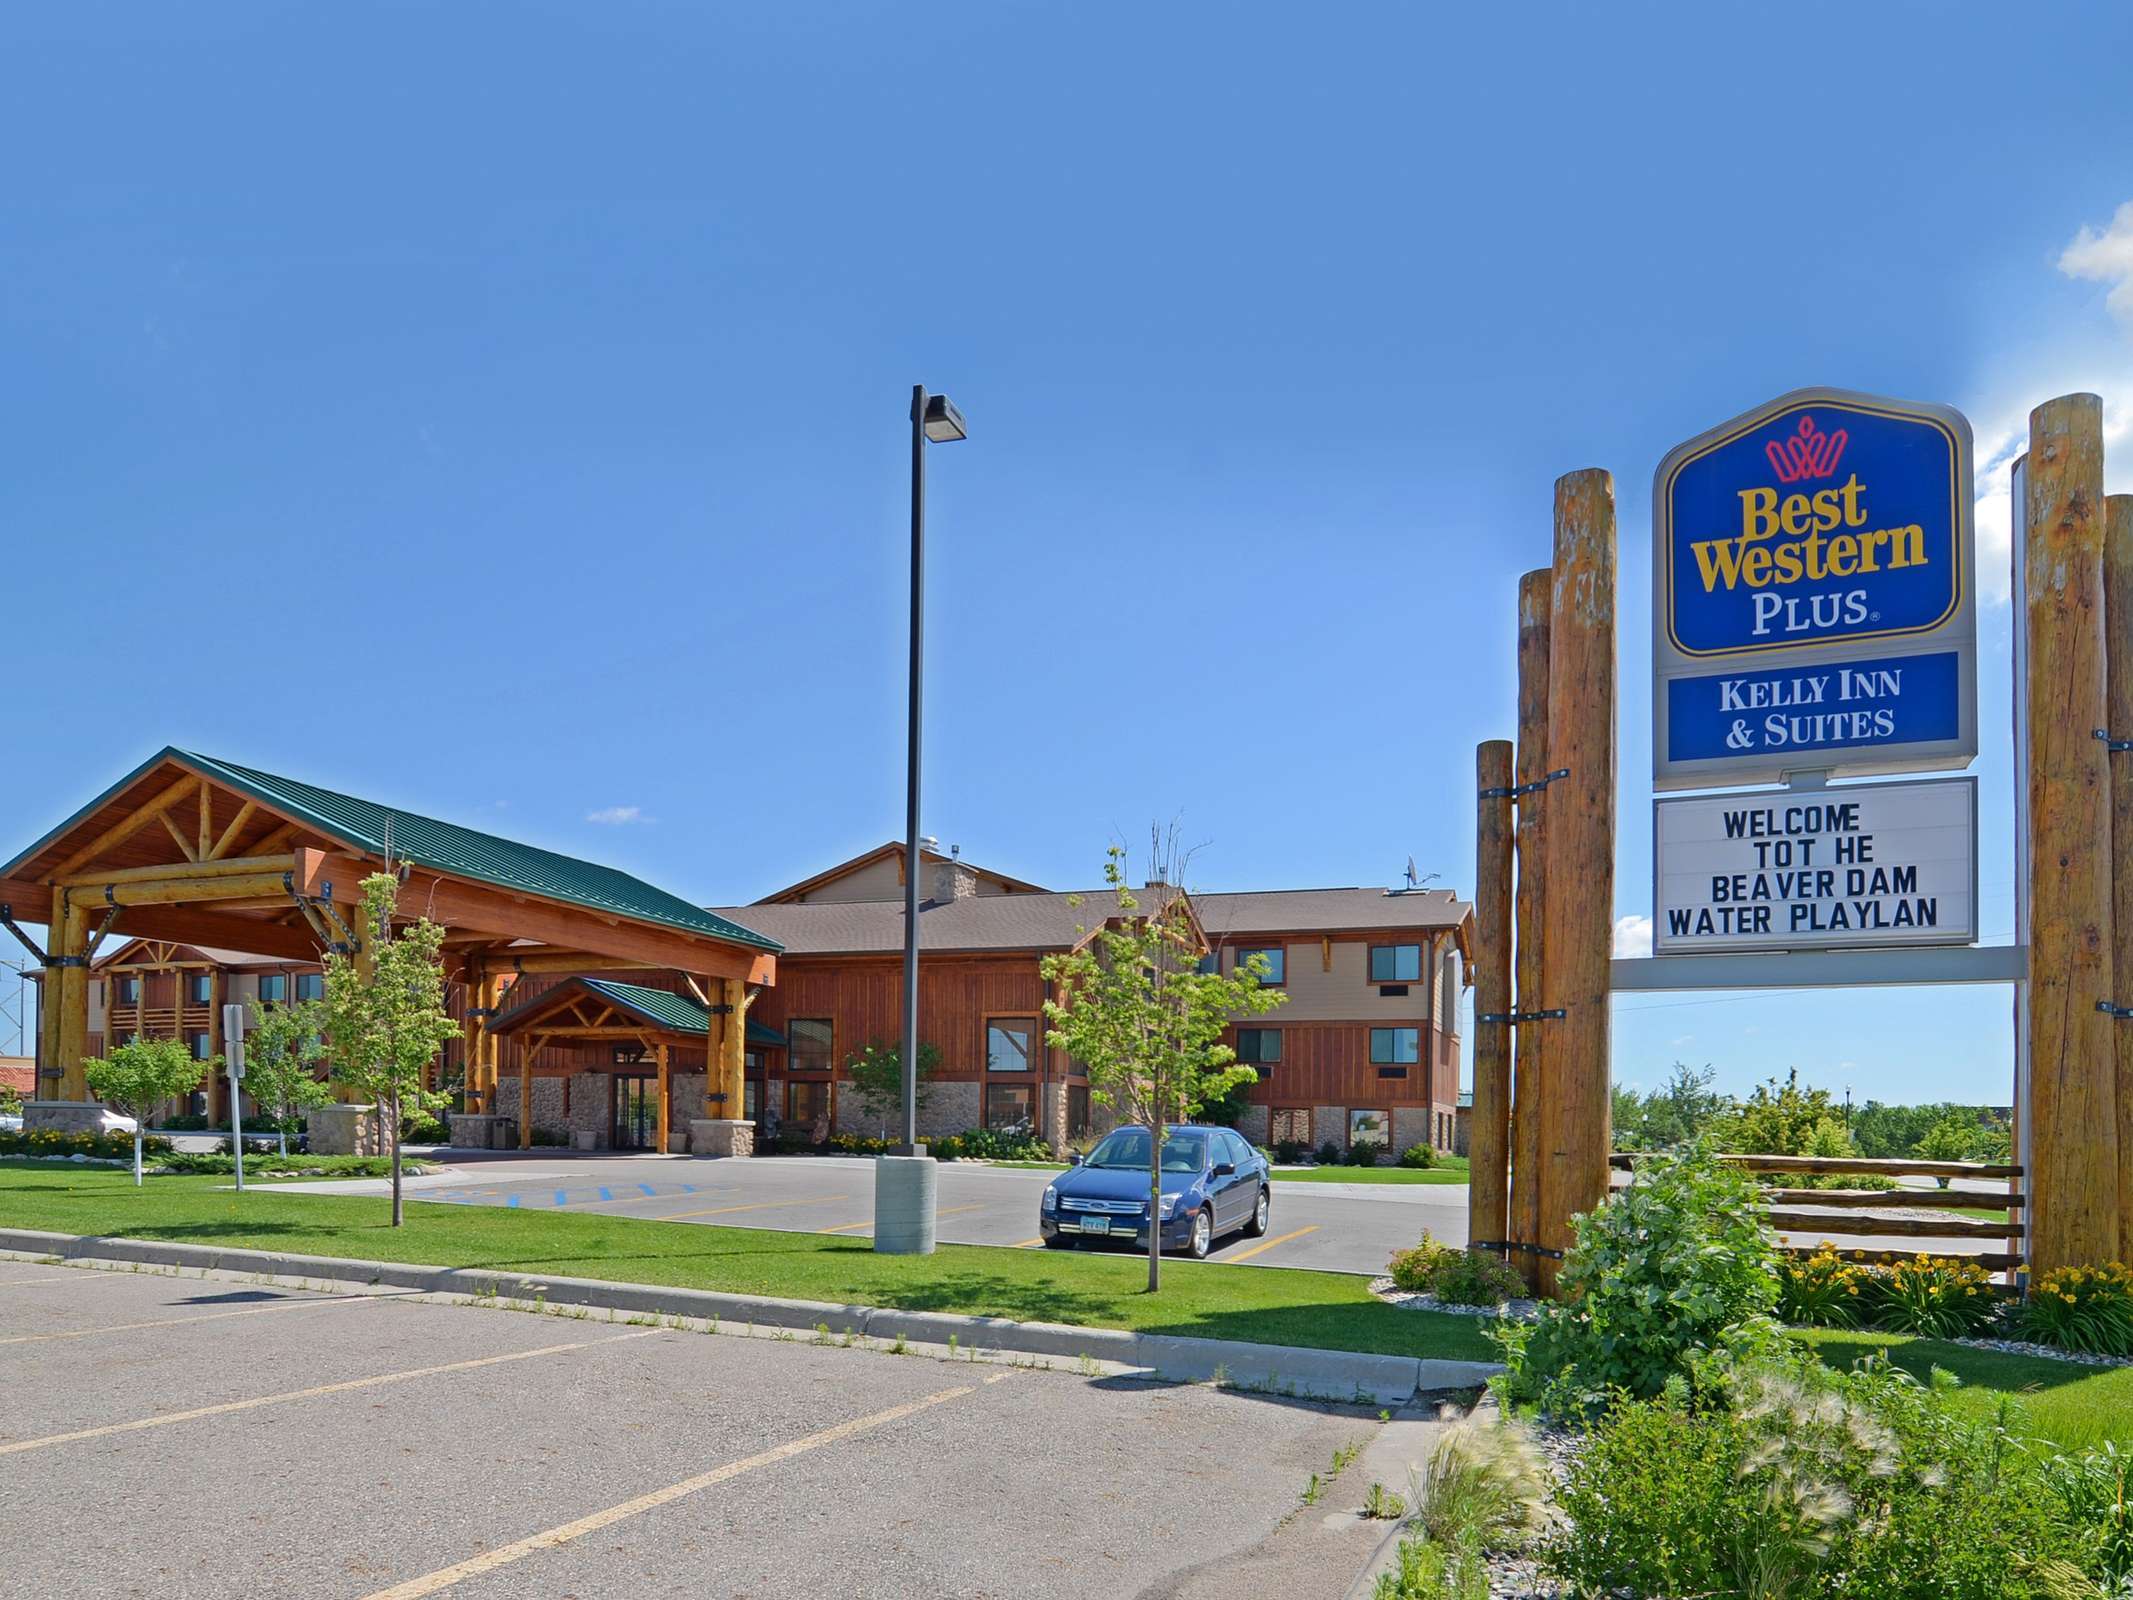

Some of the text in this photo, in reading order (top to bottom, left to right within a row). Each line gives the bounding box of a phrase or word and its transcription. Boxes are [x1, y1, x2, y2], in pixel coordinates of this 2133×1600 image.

[1737, 473, 1867, 541] Best
[1691, 519, 1928, 592] Western
[1719, 669, 1902, 711] KELLY INN
[1726, 709, 1895, 749] & SUITES
[1724, 803, 1859, 838] WELCOME
[1754, 835, 1873, 868] TOT HE
[1712, 866, 1917, 902] BEAVER DAM
[1669, 898, 1937, 936] WATER PLAYLAN
